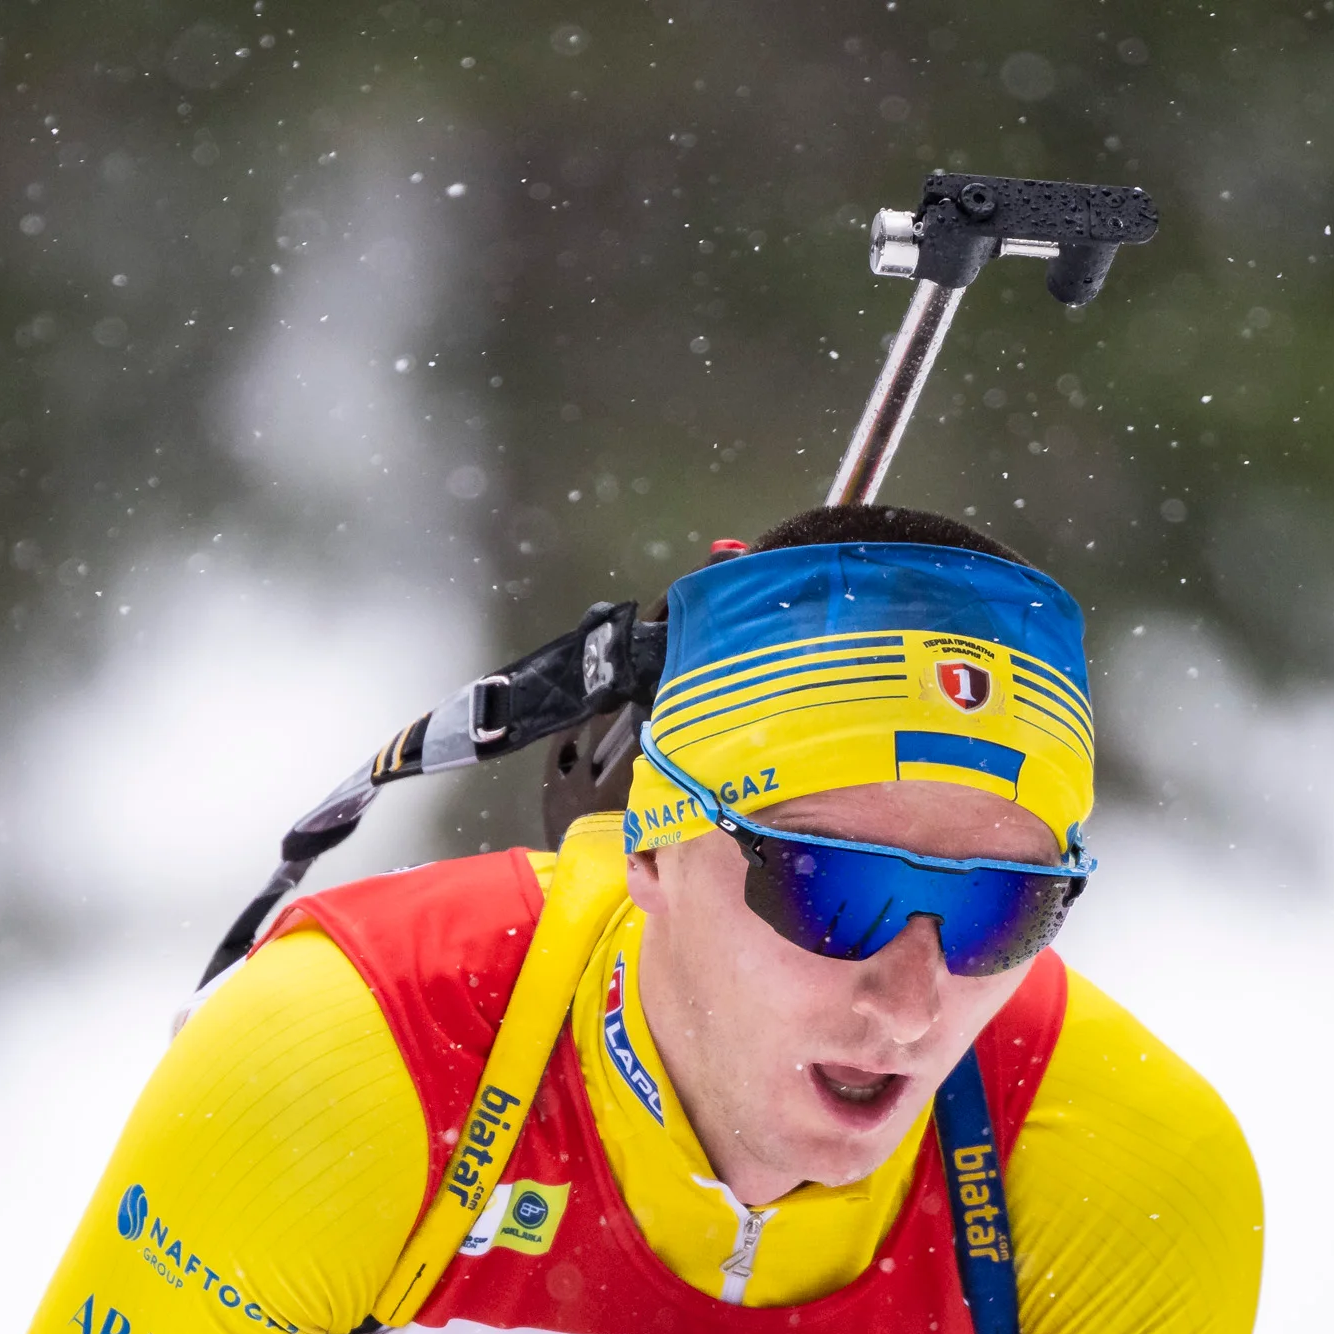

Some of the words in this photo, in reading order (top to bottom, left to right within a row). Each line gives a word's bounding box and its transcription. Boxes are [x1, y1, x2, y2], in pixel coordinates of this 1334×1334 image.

[923, 638, 954, 648] ПЕРША
[954, 639, 995, 659] ПРИВАТНА
[953, 668, 977, 702] 1
[644, 767, 780, 830] NAFTGAZ
[447, 1084, 521, 1208] biatar
[953, 1144, 1000, 1264] biatar
[142, 1247, 184, 1291] GROUP
